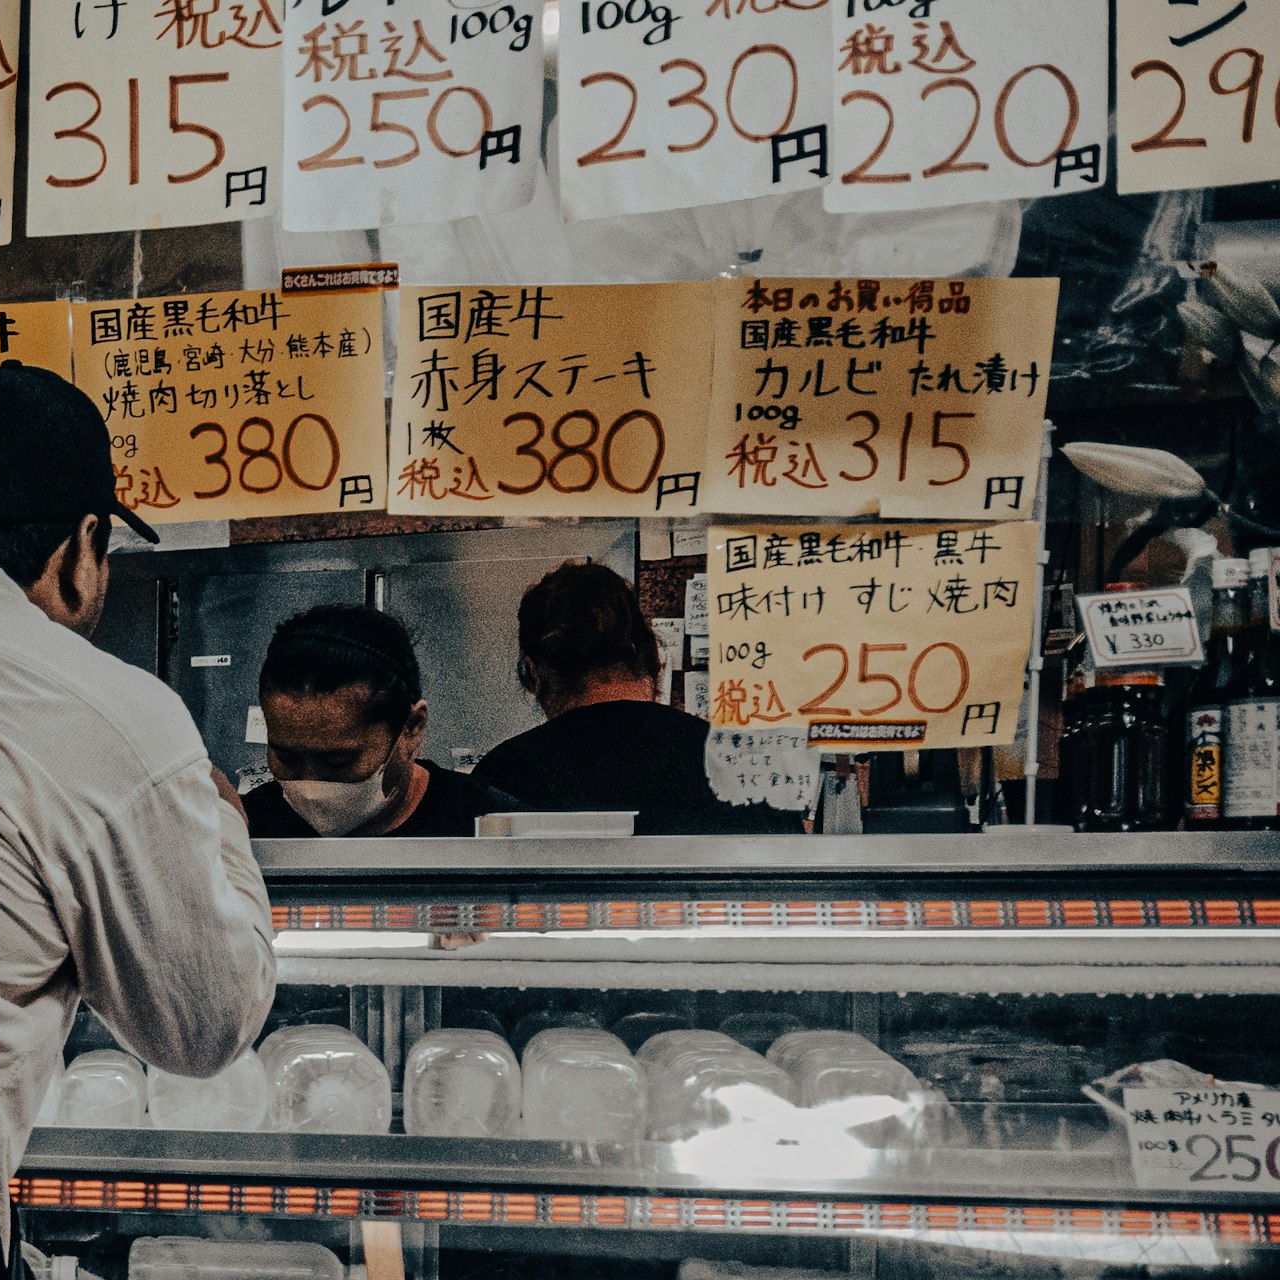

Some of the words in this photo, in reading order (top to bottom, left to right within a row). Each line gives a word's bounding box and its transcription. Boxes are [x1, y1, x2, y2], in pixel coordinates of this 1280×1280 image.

[153, 0, 284, 50] 税込
[296, 18, 454, 84] 税込
[449, 5, 534, 53] 100g
[580, 0, 682, 46] 100g
[838, 20, 977, 76] 税込
[90, 291, 293, 346] 国産黒毛和牛
[417, 286, 564, 344] 国産牛
[740, 279, 971, 315] 本日のお買い得品
[740, 316, 936, 354] 国産黒毛和牛
[102, 369, 316, 422] 焼肉切り落とし
[410, 348, 657, 413] 赤身ステーキ
[754, 357, 883, 400] カルビ
[908, 352, 1041, 398] たれ漬け
[407, 419, 465, 456] 1枚
[735, 402, 804, 431] 100g
[397, 456, 496, 501] 税込
[725, 432, 829, 489] 税込
[717, 581, 826, 622] 味付け
[717, 640, 772, 669] 100g
[711, 678, 793, 727] 税込
